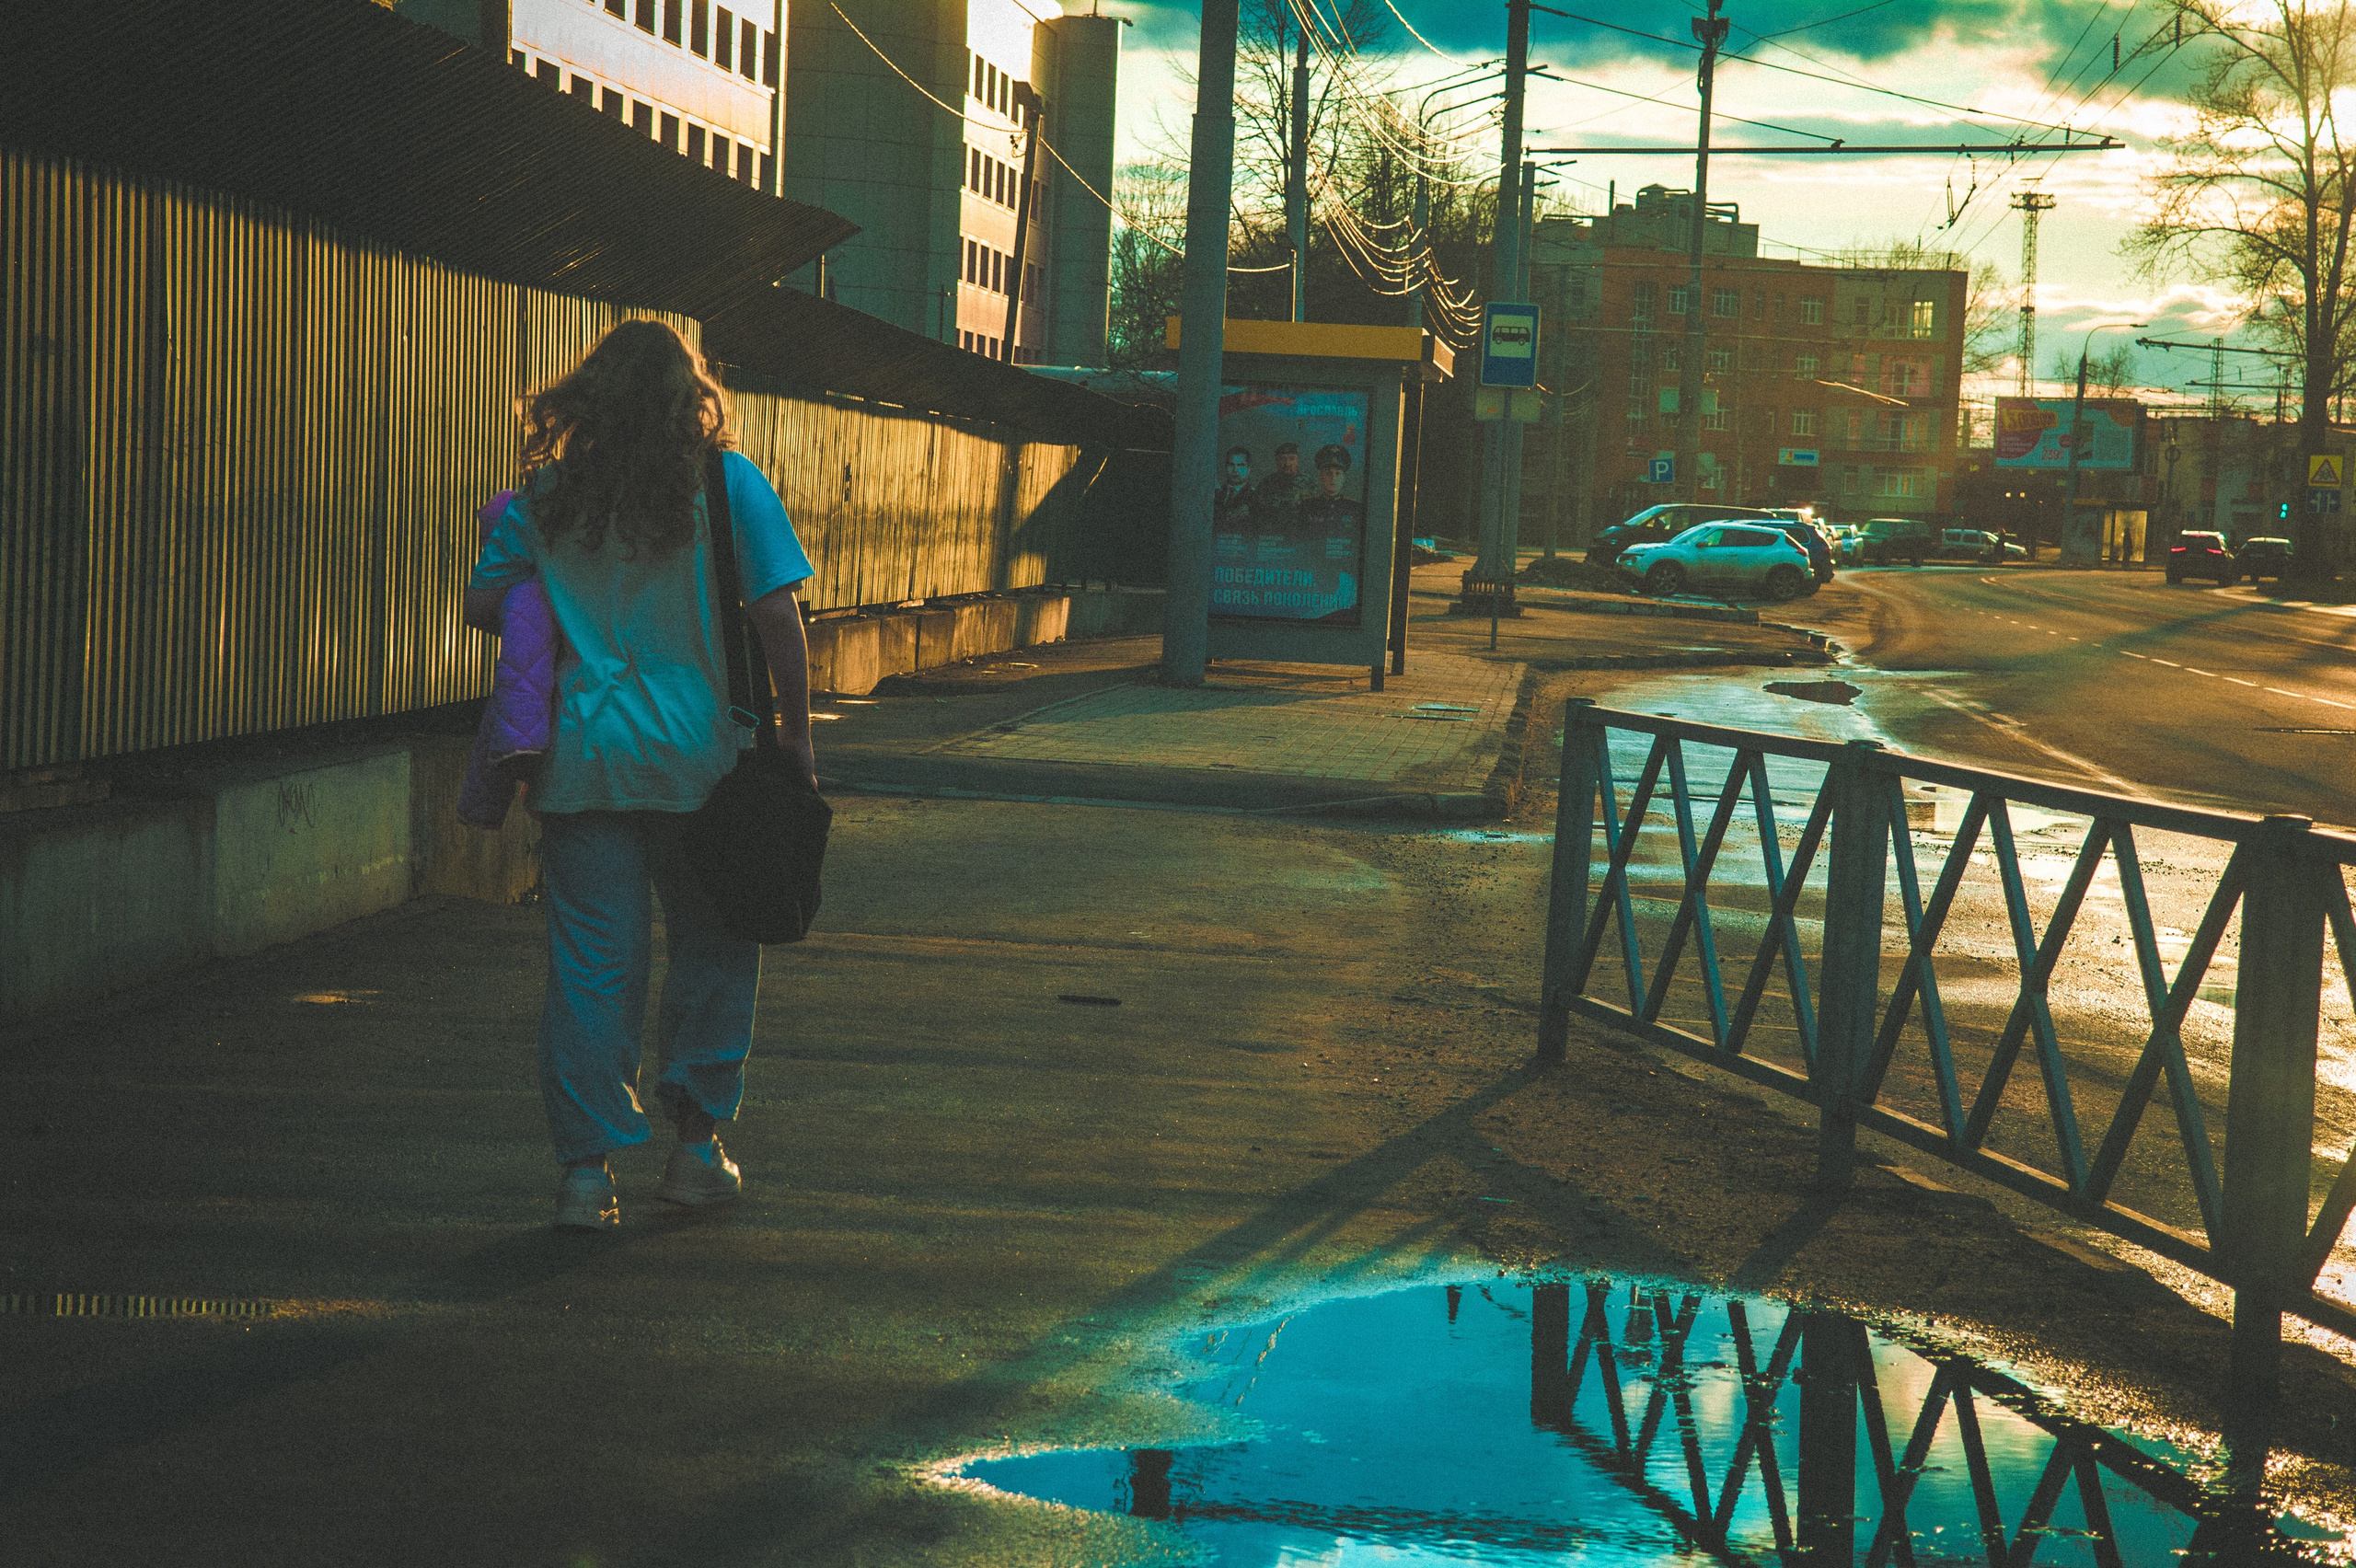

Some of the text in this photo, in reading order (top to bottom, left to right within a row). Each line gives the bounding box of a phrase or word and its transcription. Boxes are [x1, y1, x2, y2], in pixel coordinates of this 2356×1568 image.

[1656, 461, 1669, 480] P
[1214, 566, 1317, 587] ПОБЕДИТЕЛИ.
[1213, 588, 1259, 605] СВЯЗЬ
